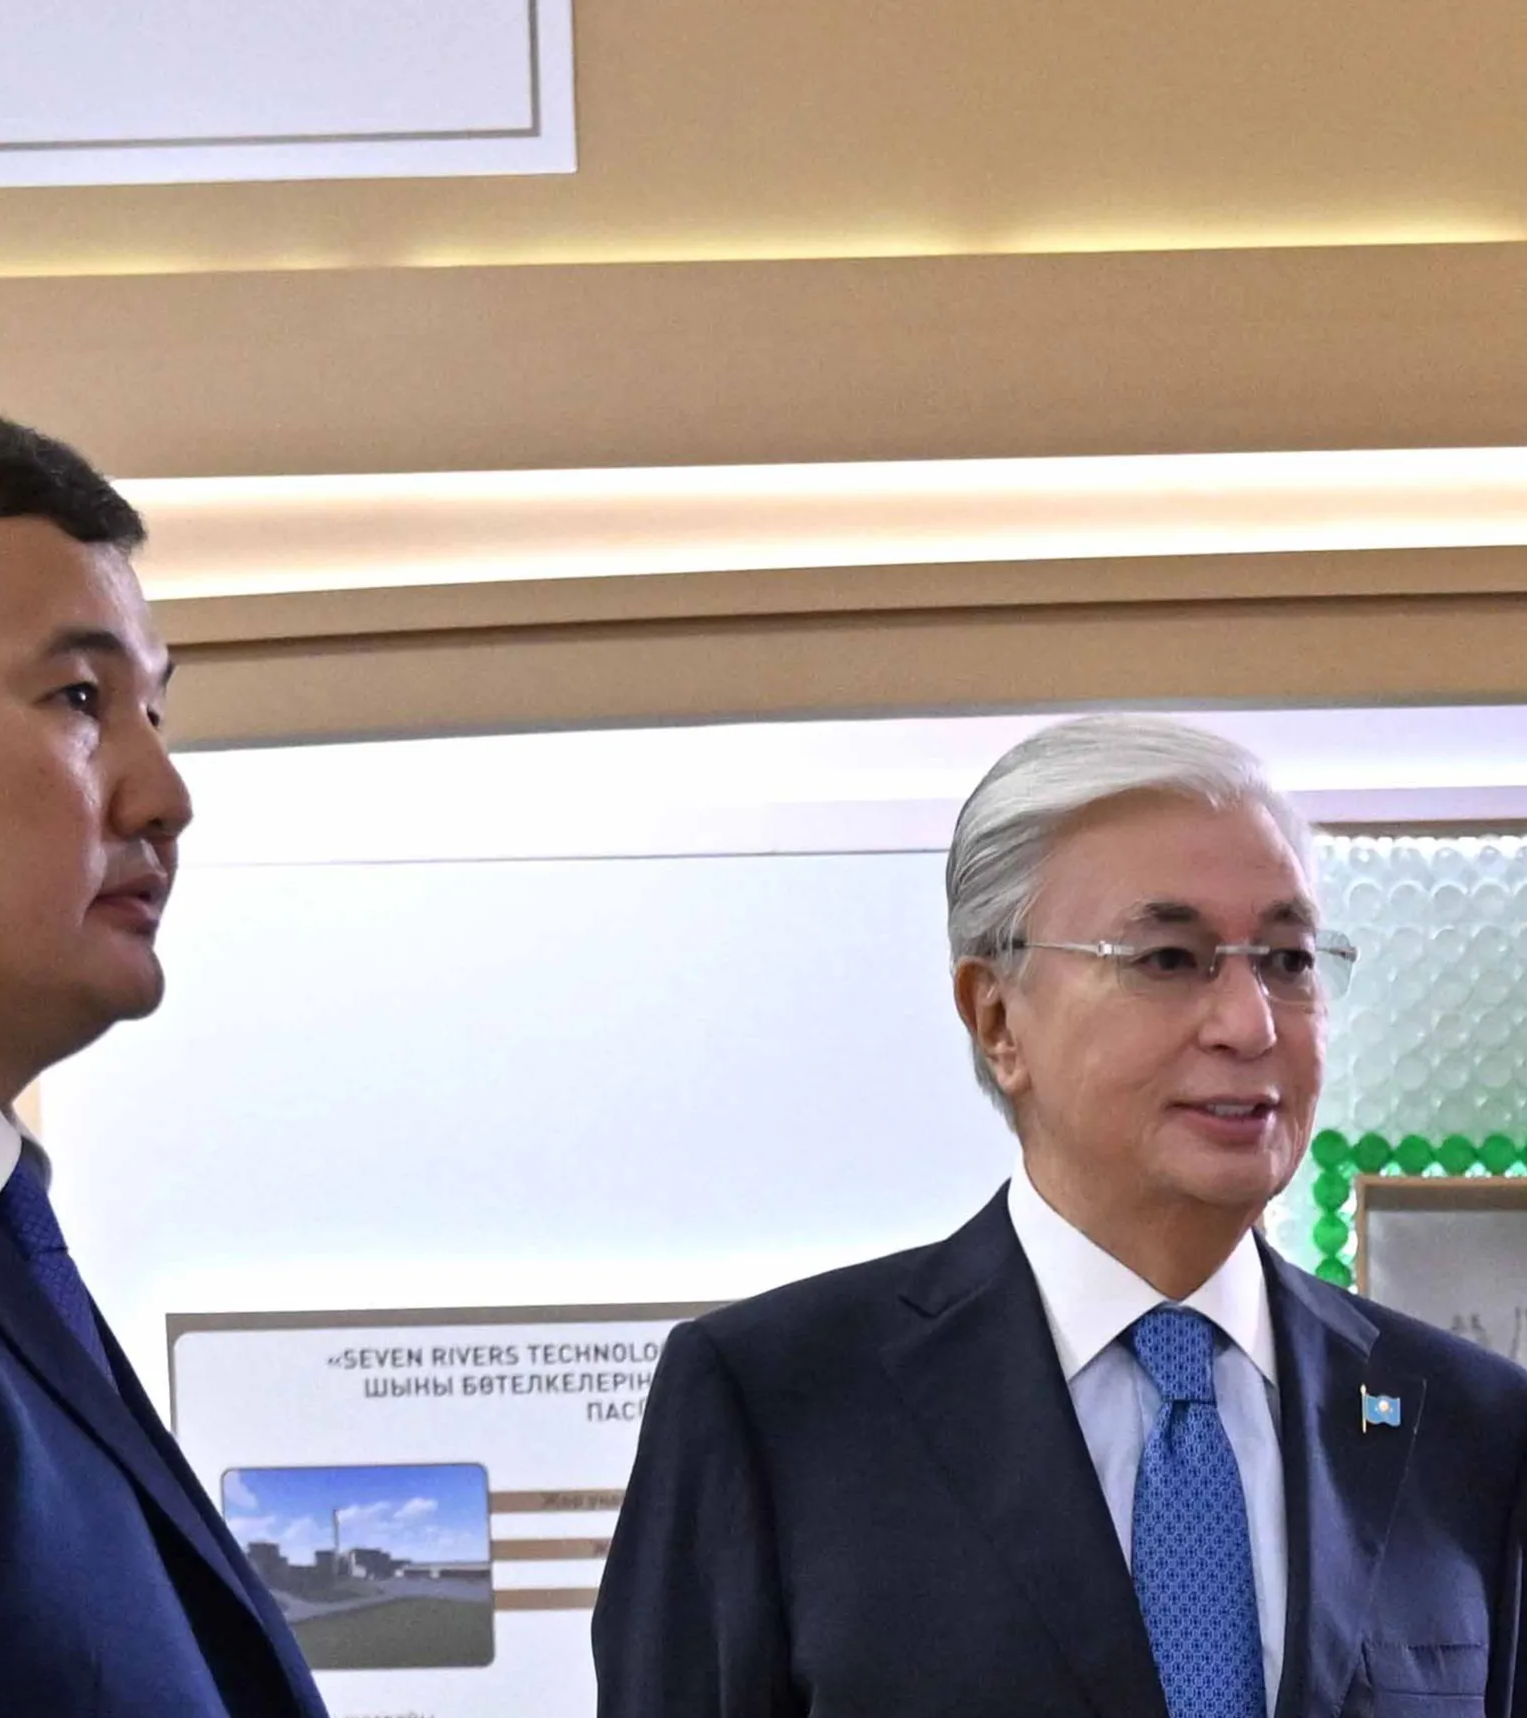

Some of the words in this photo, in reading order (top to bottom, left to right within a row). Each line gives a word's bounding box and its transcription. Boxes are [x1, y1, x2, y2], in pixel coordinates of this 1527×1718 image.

[328, 1347, 423, 1370] «SEVEN
[431, 1345, 520, 1367] RIVERS
[528, 1342, 663, 1366] TECHNOLO
[365, 1376, 453, 1398] ШЫНЫ
